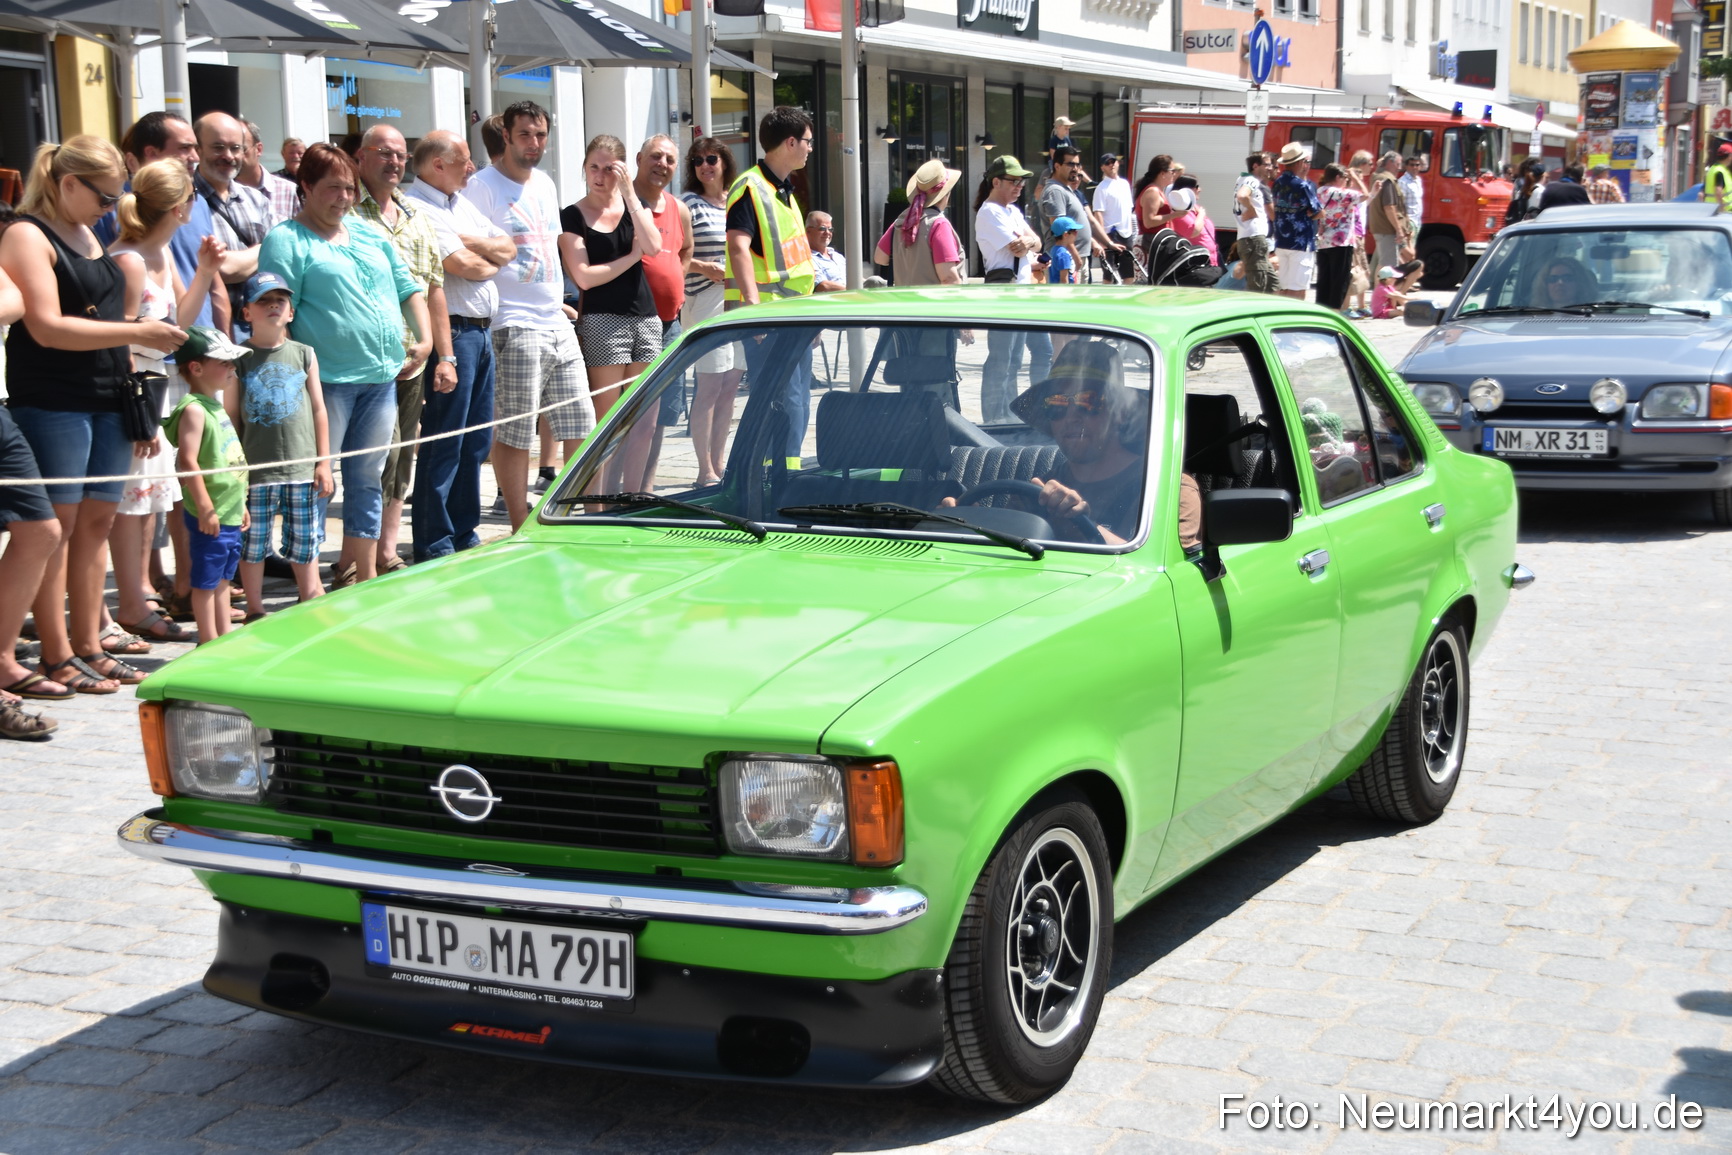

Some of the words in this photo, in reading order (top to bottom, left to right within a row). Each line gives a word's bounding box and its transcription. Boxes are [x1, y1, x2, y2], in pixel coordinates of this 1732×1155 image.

[85, 62, 104, 86] 24
[346, 104, 357, 115] die
[357, 105, 385, 118] günstige
[1496, 430, 1521, 449] NM
[1535, 431, 1560, 450] XR
[1566, 432, 1590, 450] 31
[374, 939, 382, 952] D
[388, 913, 459, 966] HIP
[490, 926, 539, 979] MA
[551, 933, 627, 989] 79H
[392, 972, 412, 982] AUTO
[478, 985, 537, 1001] UNTERMÄSSING
[544, 994, 560, 1004] TEL.
